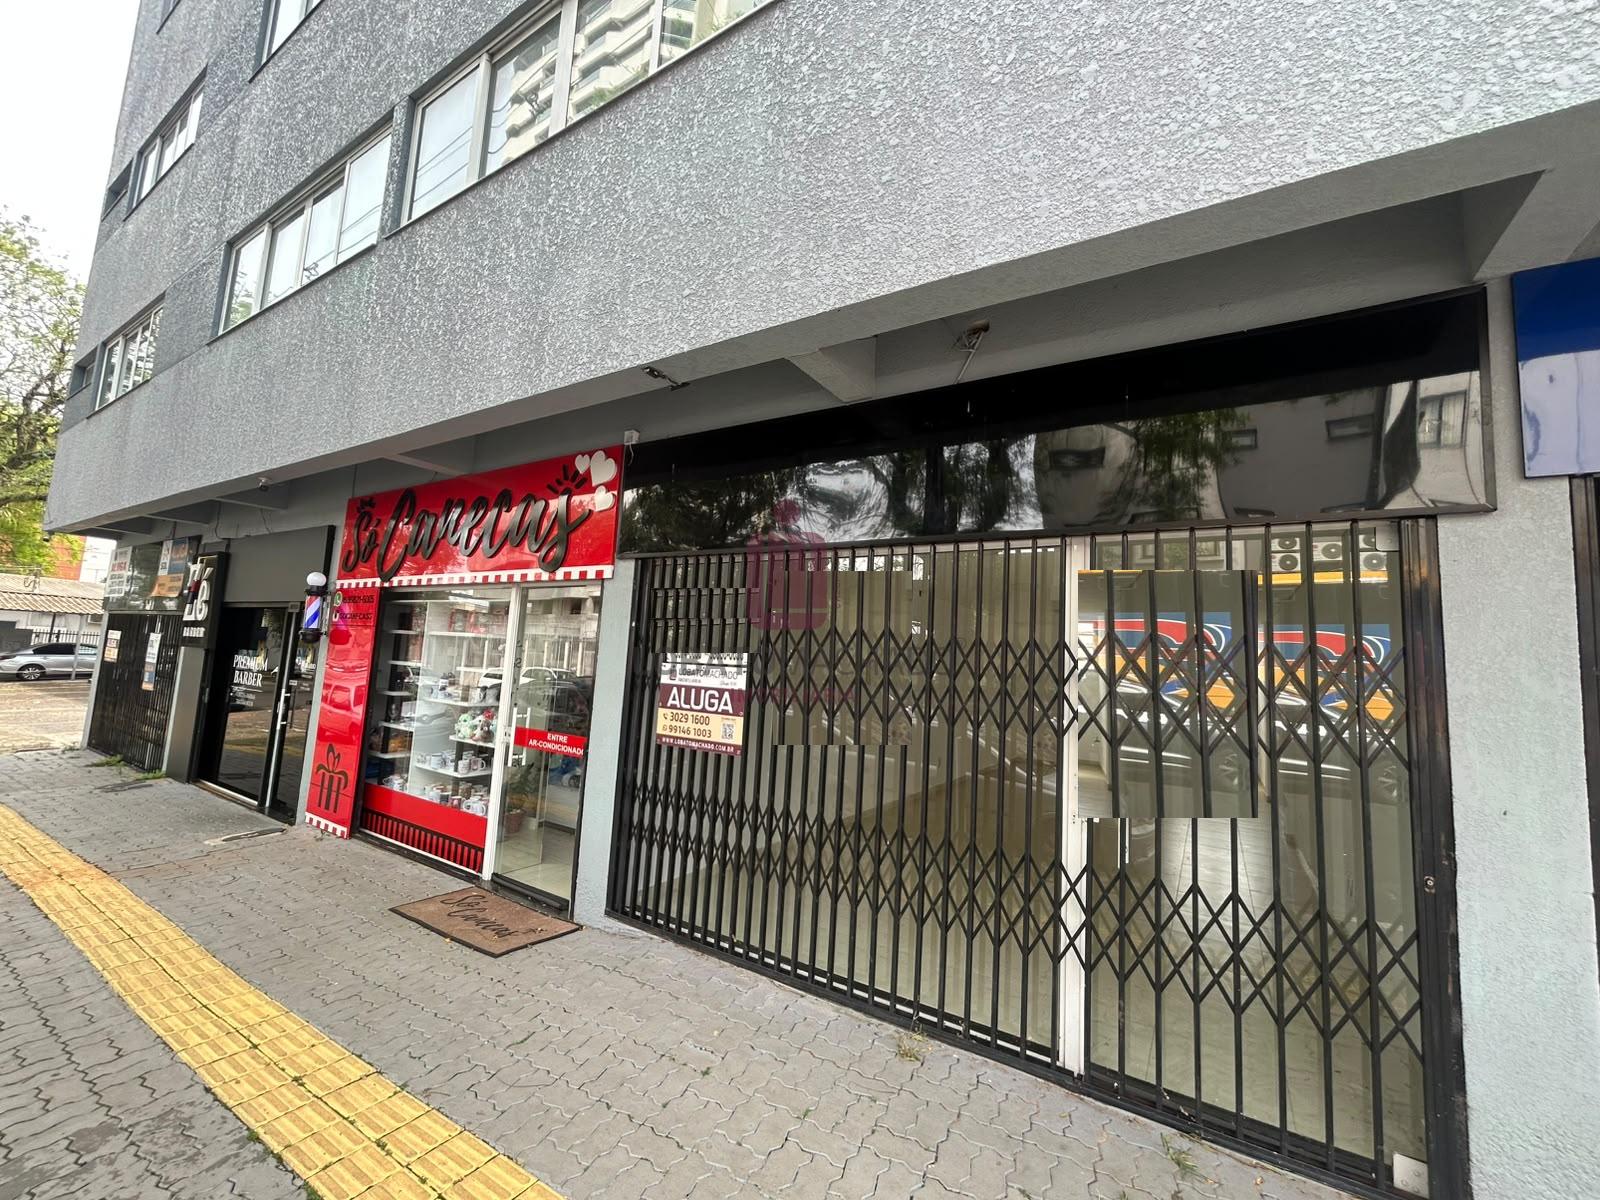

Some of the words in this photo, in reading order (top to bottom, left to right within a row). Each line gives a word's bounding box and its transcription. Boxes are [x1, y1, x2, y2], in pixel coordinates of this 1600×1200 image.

[232, 654, 269, 672] PREMIUM
[233, 670, 263, 687] BARBER
[666, 686, 733, 714] ALUGA
[669, 712, 689, 723] 3029
[691, 714, 710, 726] 1600
[547, 733, 568, 743] ENTRE
[668, 724, 691, 736] 99146
[693, 727, 712, 738] 1003
